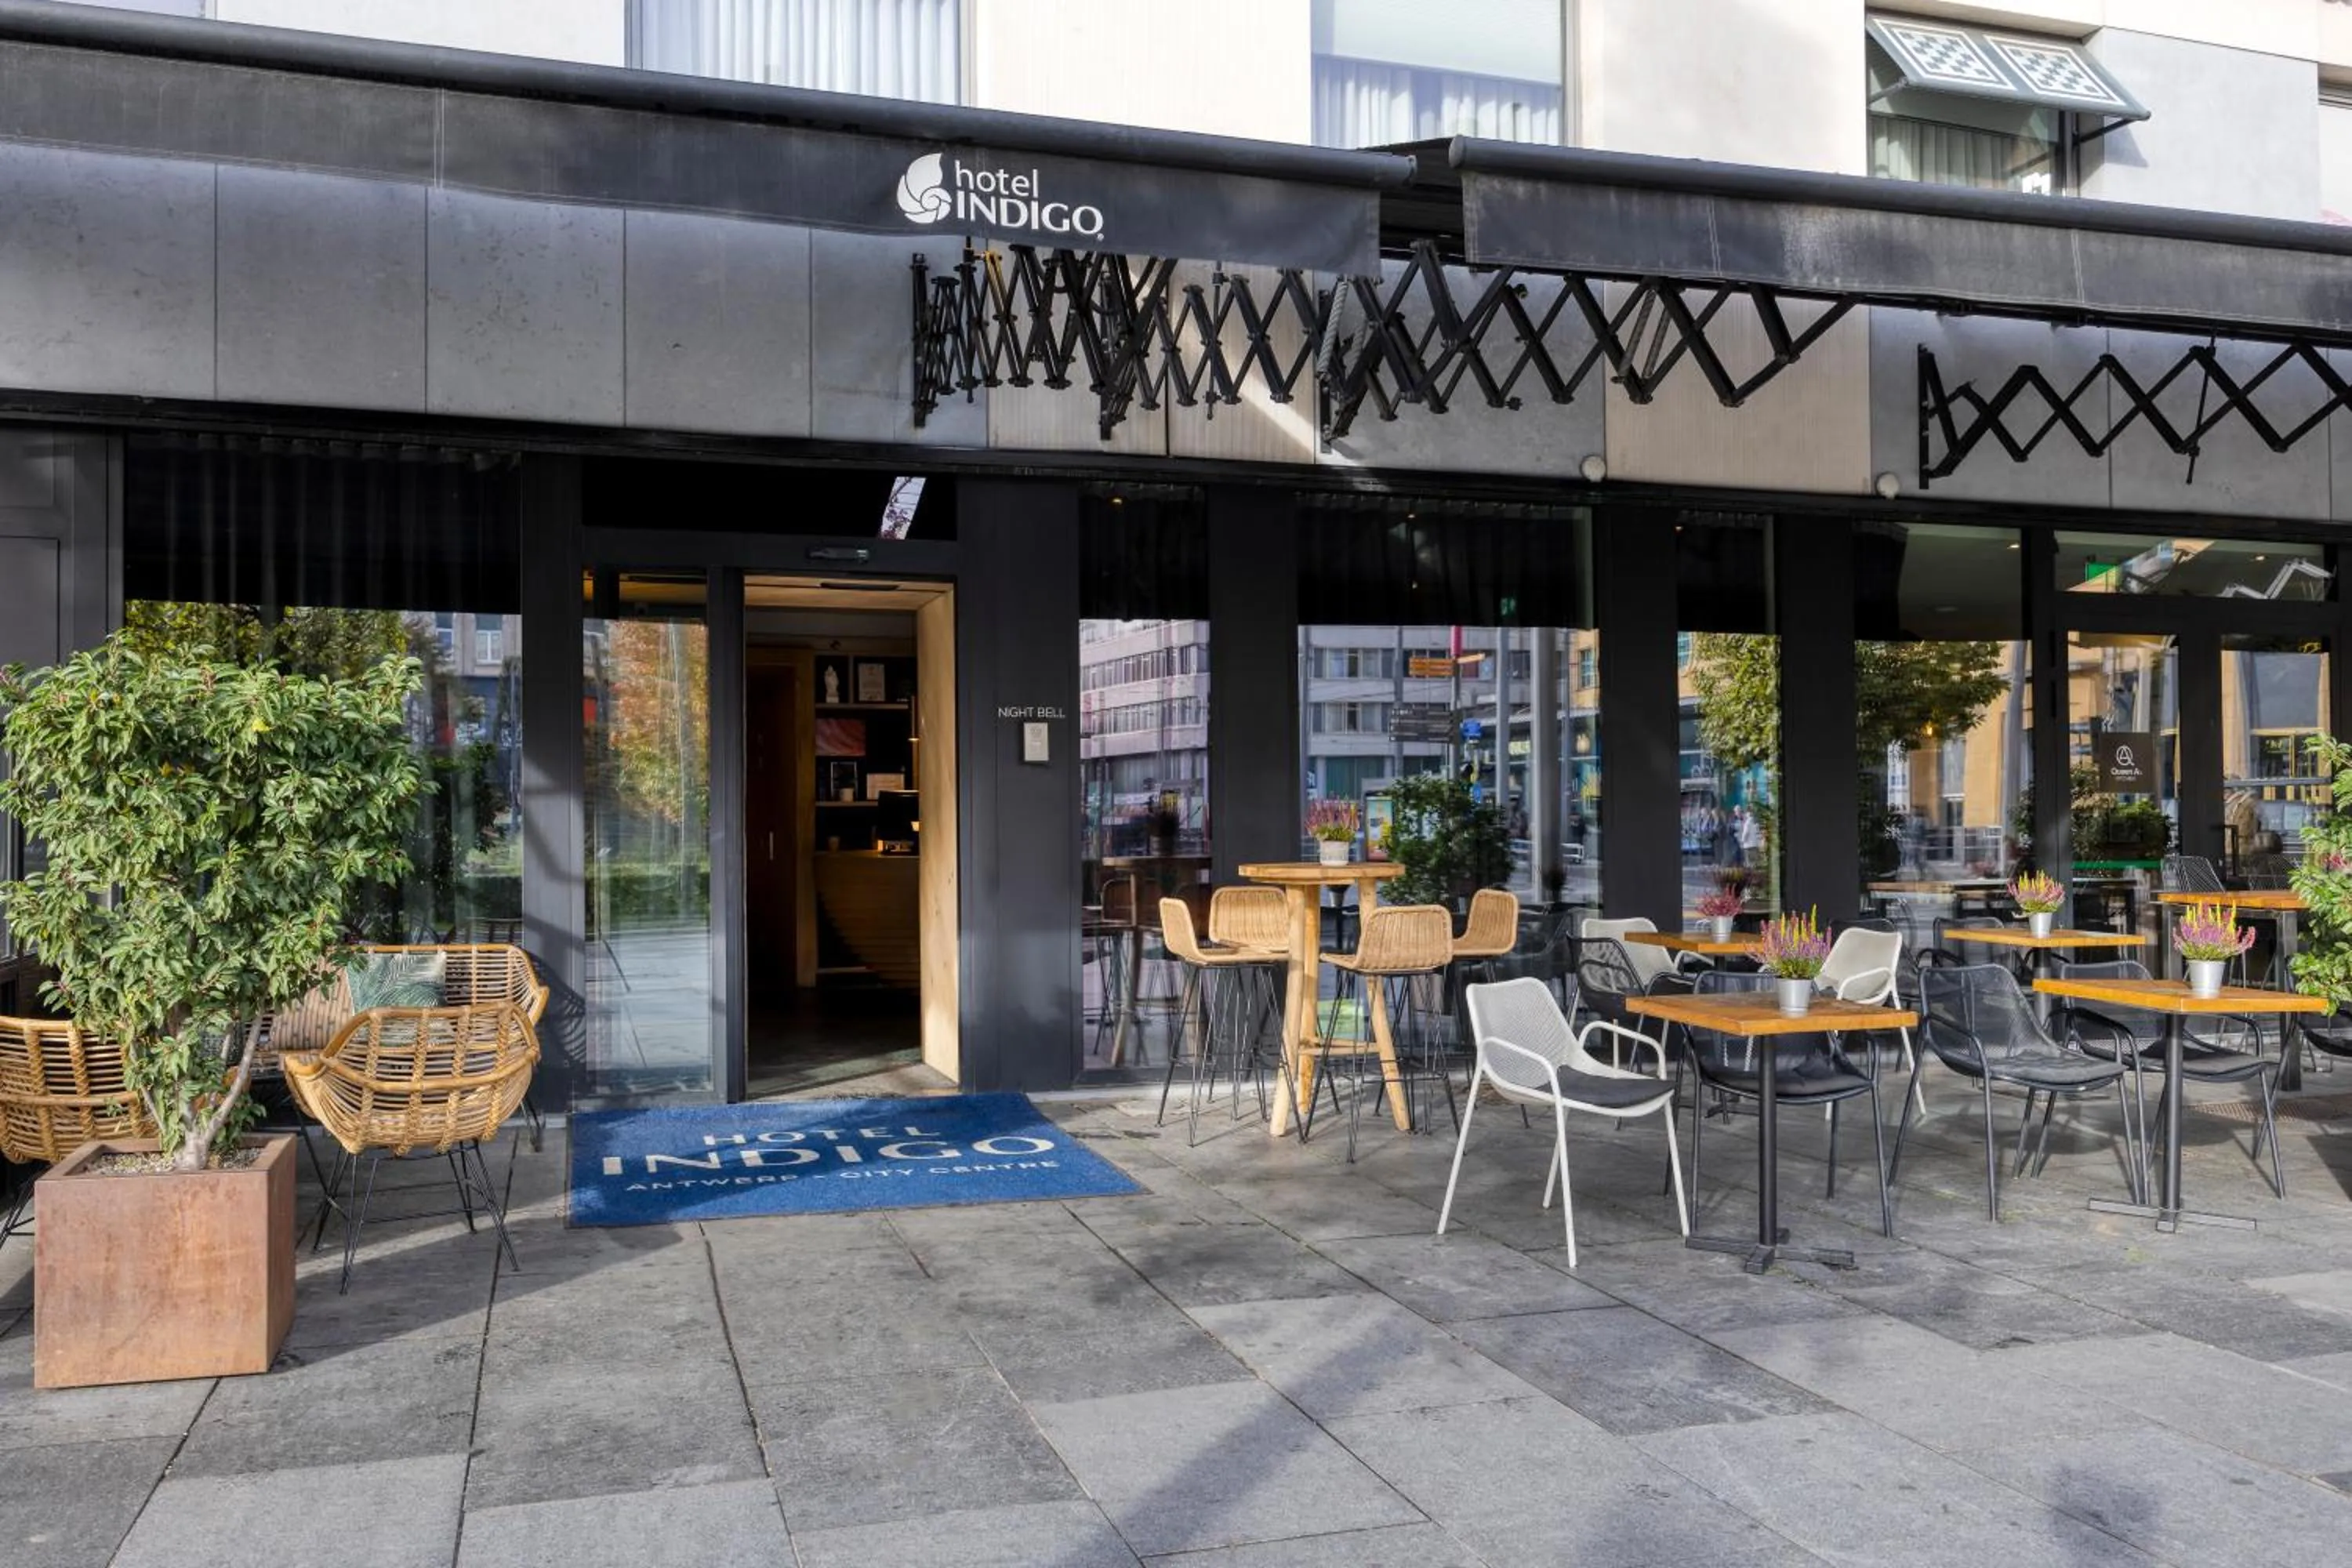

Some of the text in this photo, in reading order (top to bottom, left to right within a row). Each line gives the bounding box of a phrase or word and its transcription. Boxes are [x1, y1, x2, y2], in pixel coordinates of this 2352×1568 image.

[954, 159, 1039, 198] hotel
[956, 189, 1104, 234] INDIGO
[998, 706, 1066, 719] NIGHT BELL
[702, 1127, 940, 1145] HOTEL
[602, 1136, 1055, 1175] INDIGO
[625, 1175, 799, 1192] ANTWERP
[839, 1166, 914, 1178] CITY
[927, 1160, 1060, 1174] CENTRE
